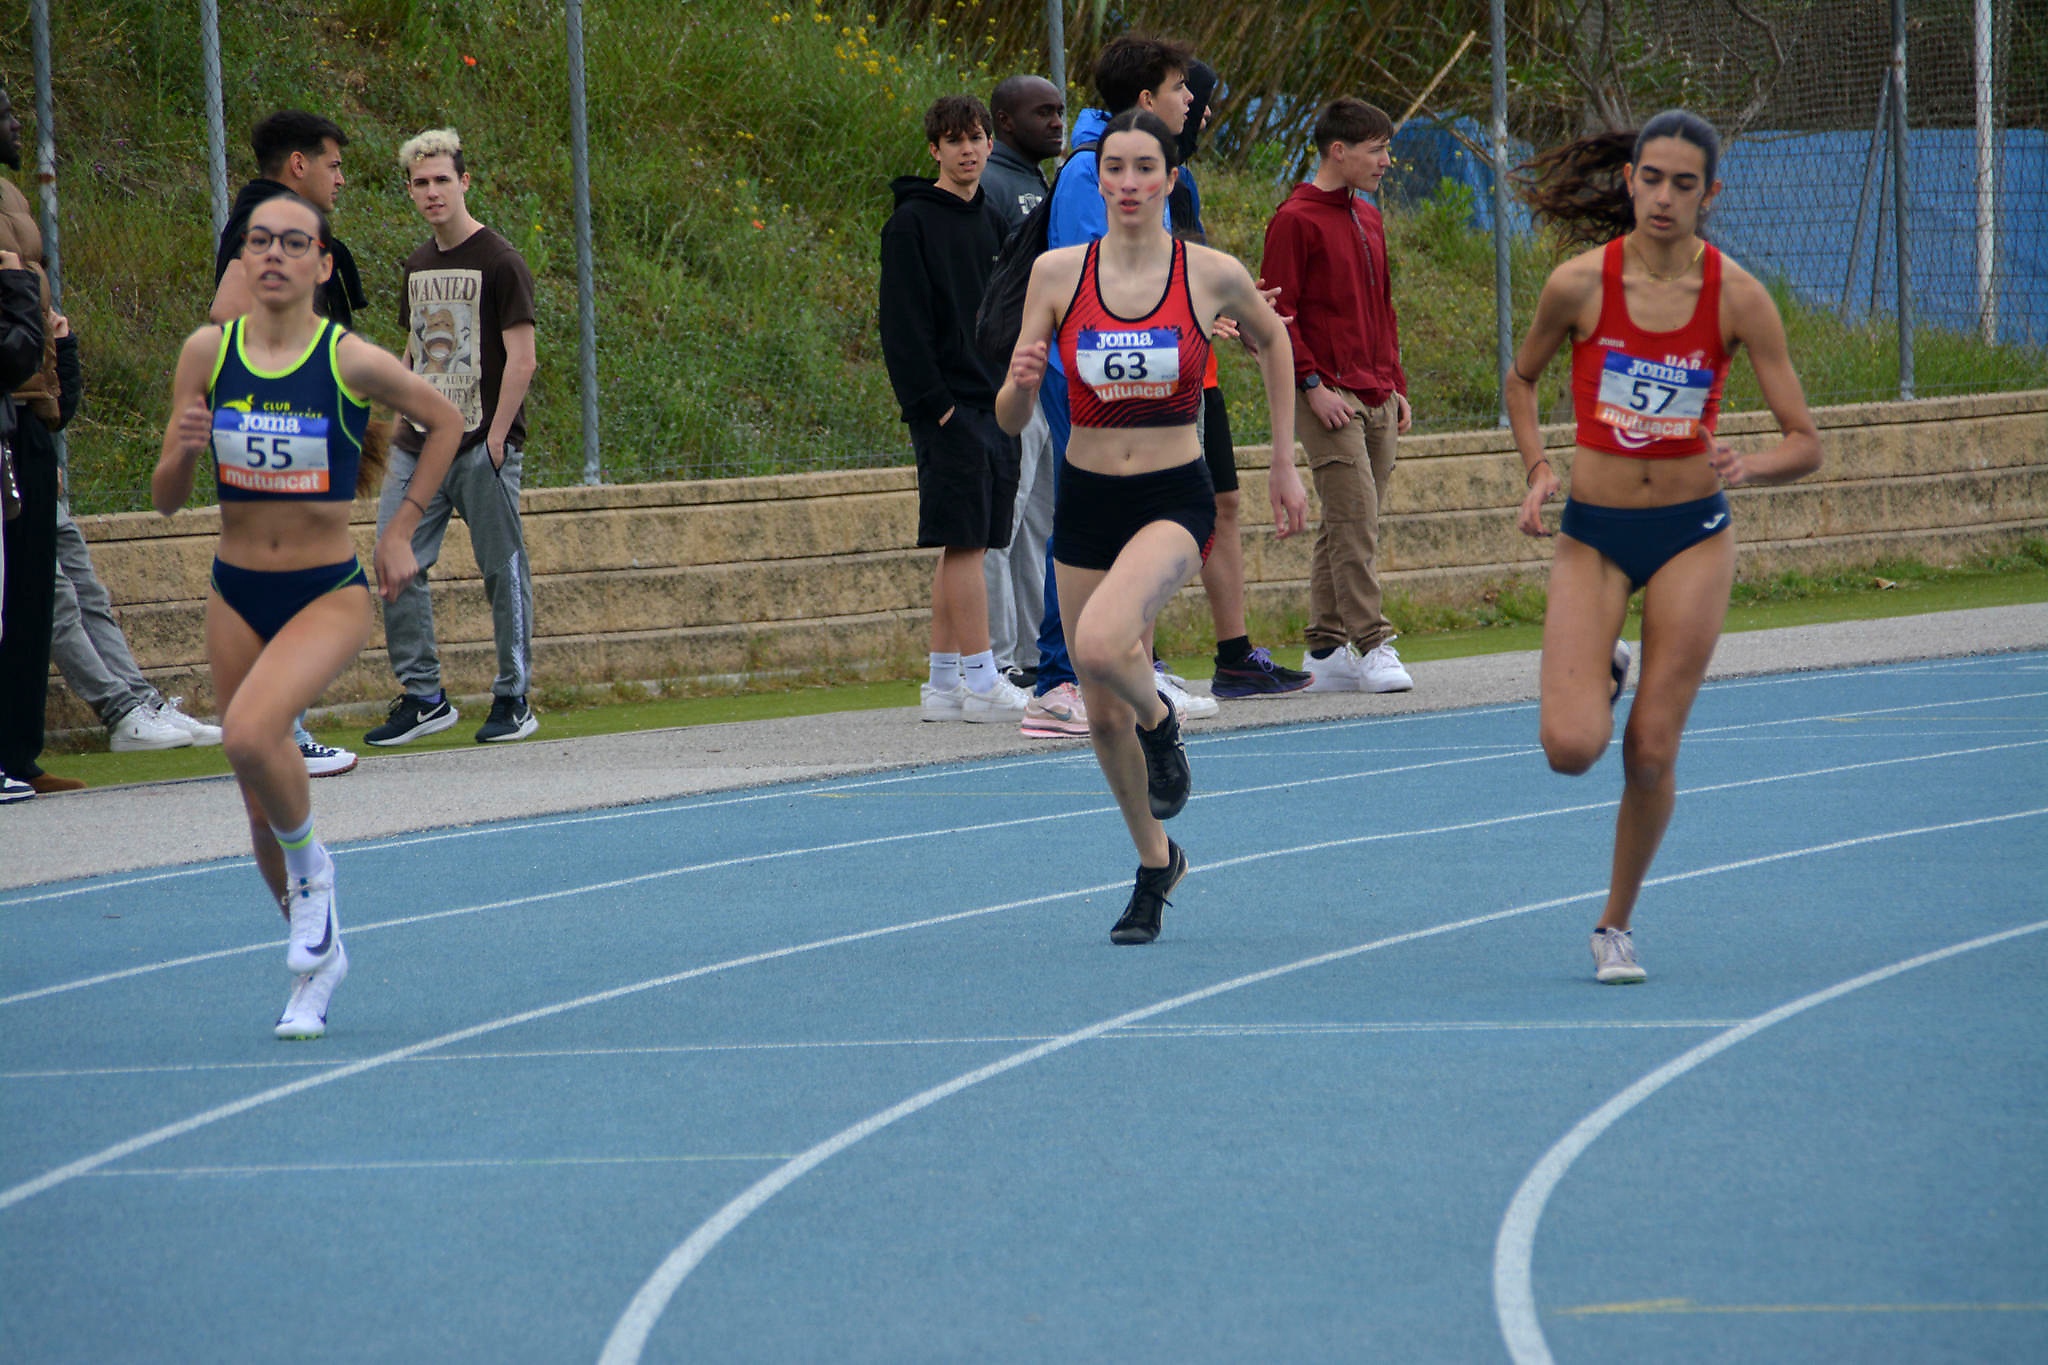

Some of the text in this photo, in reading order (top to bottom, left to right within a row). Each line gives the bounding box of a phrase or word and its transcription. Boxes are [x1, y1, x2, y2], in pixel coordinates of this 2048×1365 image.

[410, 277, 477, 301] WANTED
[1104, 352, 1148, 380] 63
[263, 402, 291, 411] CLUB
[1629, 380, 1678, 414] 57
[1602, 406, 1692, 437] mutuacat
[246, 436, 293, 469] 55
[225, 468, 320, 491] mutuacat
